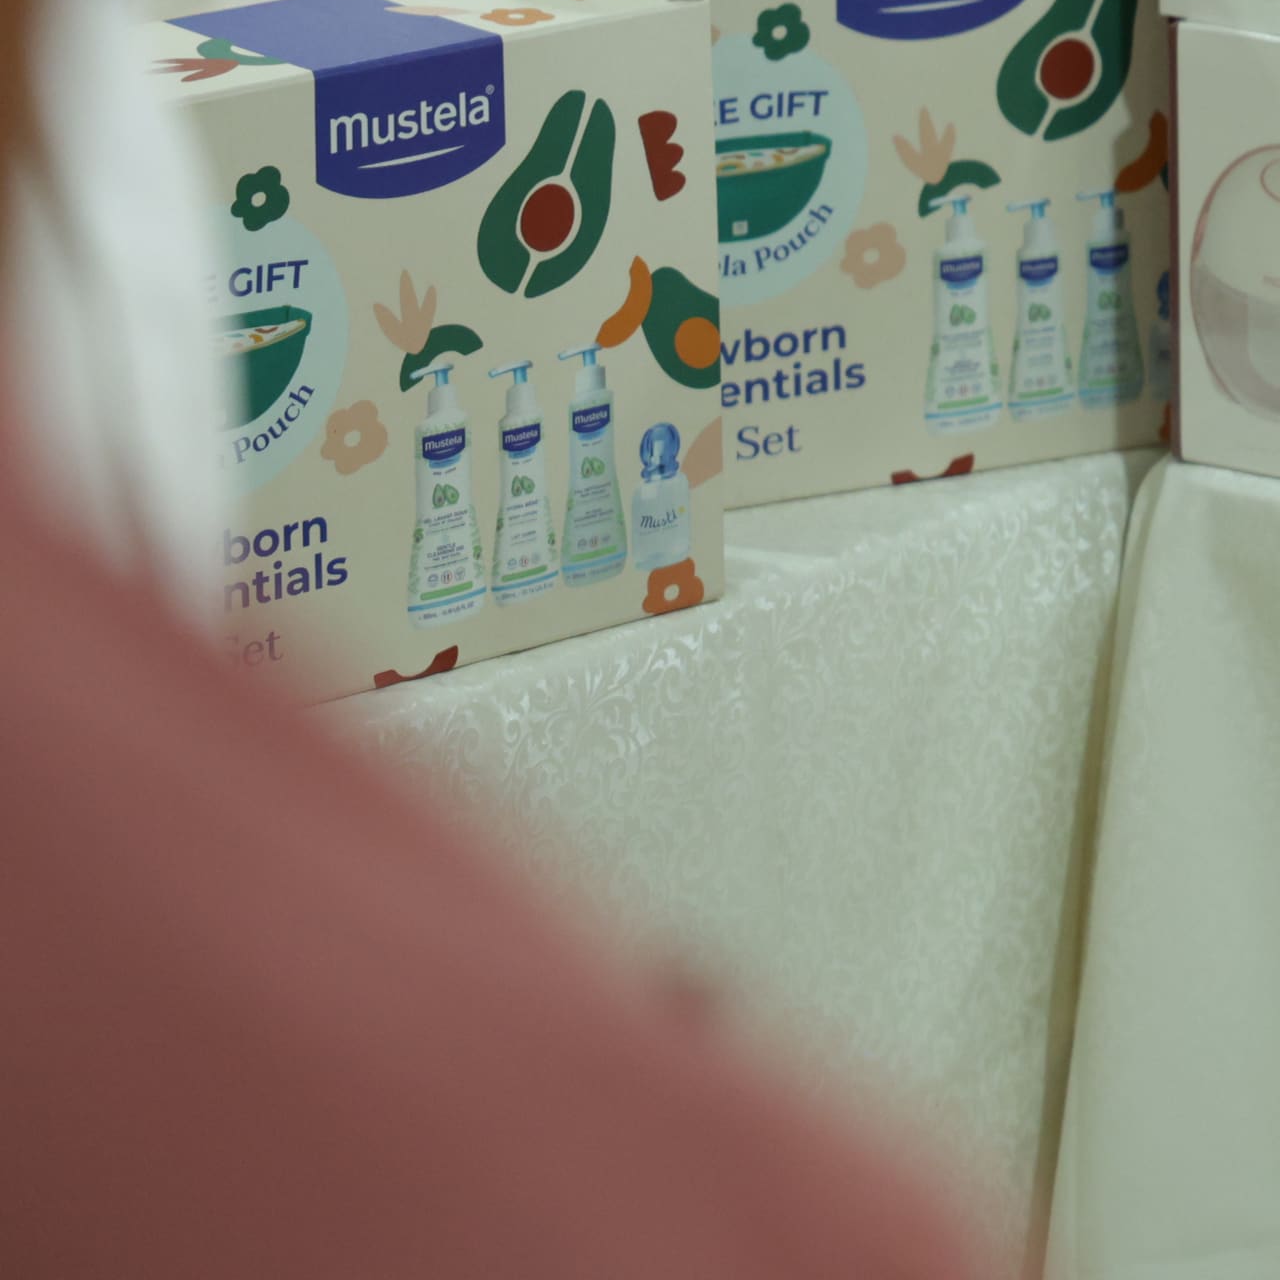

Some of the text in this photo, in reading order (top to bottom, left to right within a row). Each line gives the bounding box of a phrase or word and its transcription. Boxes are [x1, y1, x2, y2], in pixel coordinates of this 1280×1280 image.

[750, 90, 829, 120] GIFT
[755, 203, 834, 266] Pouch
[228, 260, 309, 298] GIFT
[721, 360, 867, 409] entials
[232, 384, 315, 465] Pouch
[736, 421, 803, 462] Set
[223, 516, 328, 566] born
[223, 552, 348, 614] ntials
